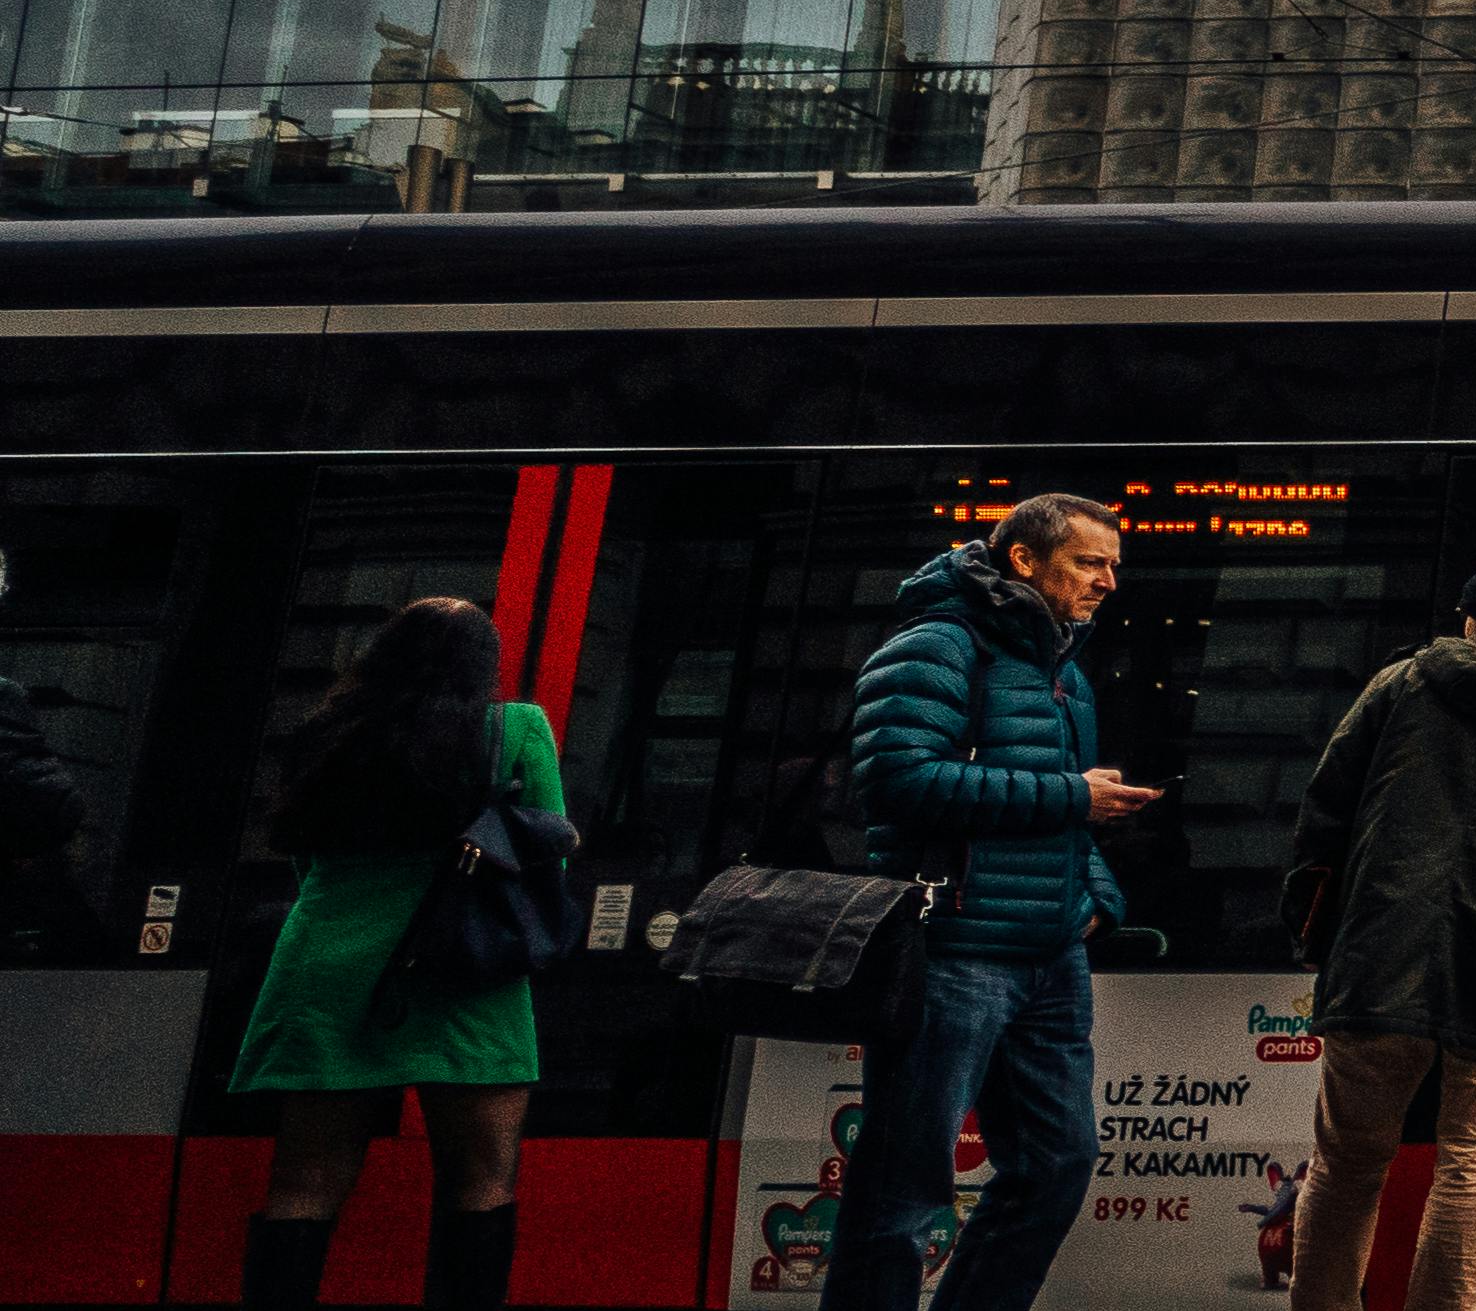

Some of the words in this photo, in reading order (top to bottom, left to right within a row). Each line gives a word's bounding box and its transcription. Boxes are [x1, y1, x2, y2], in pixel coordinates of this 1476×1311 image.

[1263, 1040, 1316, 1059] pants
[1105, 1075, 1143, 1105] UŽ
[1152, 1075, 1250, 1105] ŽÁDNÝ
[1100, 1117, 1208, 1140] STRACH
[827, 1160, 841, 1181] 3
[1097, 1153, 1115, 1176] Z
[1124, 1153, 1270, 1177] KAKAMITY
[1095, 1197, 1146, 1221] 899
[1157, 1196, 1189, 1221] Kč
[778, 1223, 833, 1244] Pampers
[760, 1260, 773, 1280] 4
